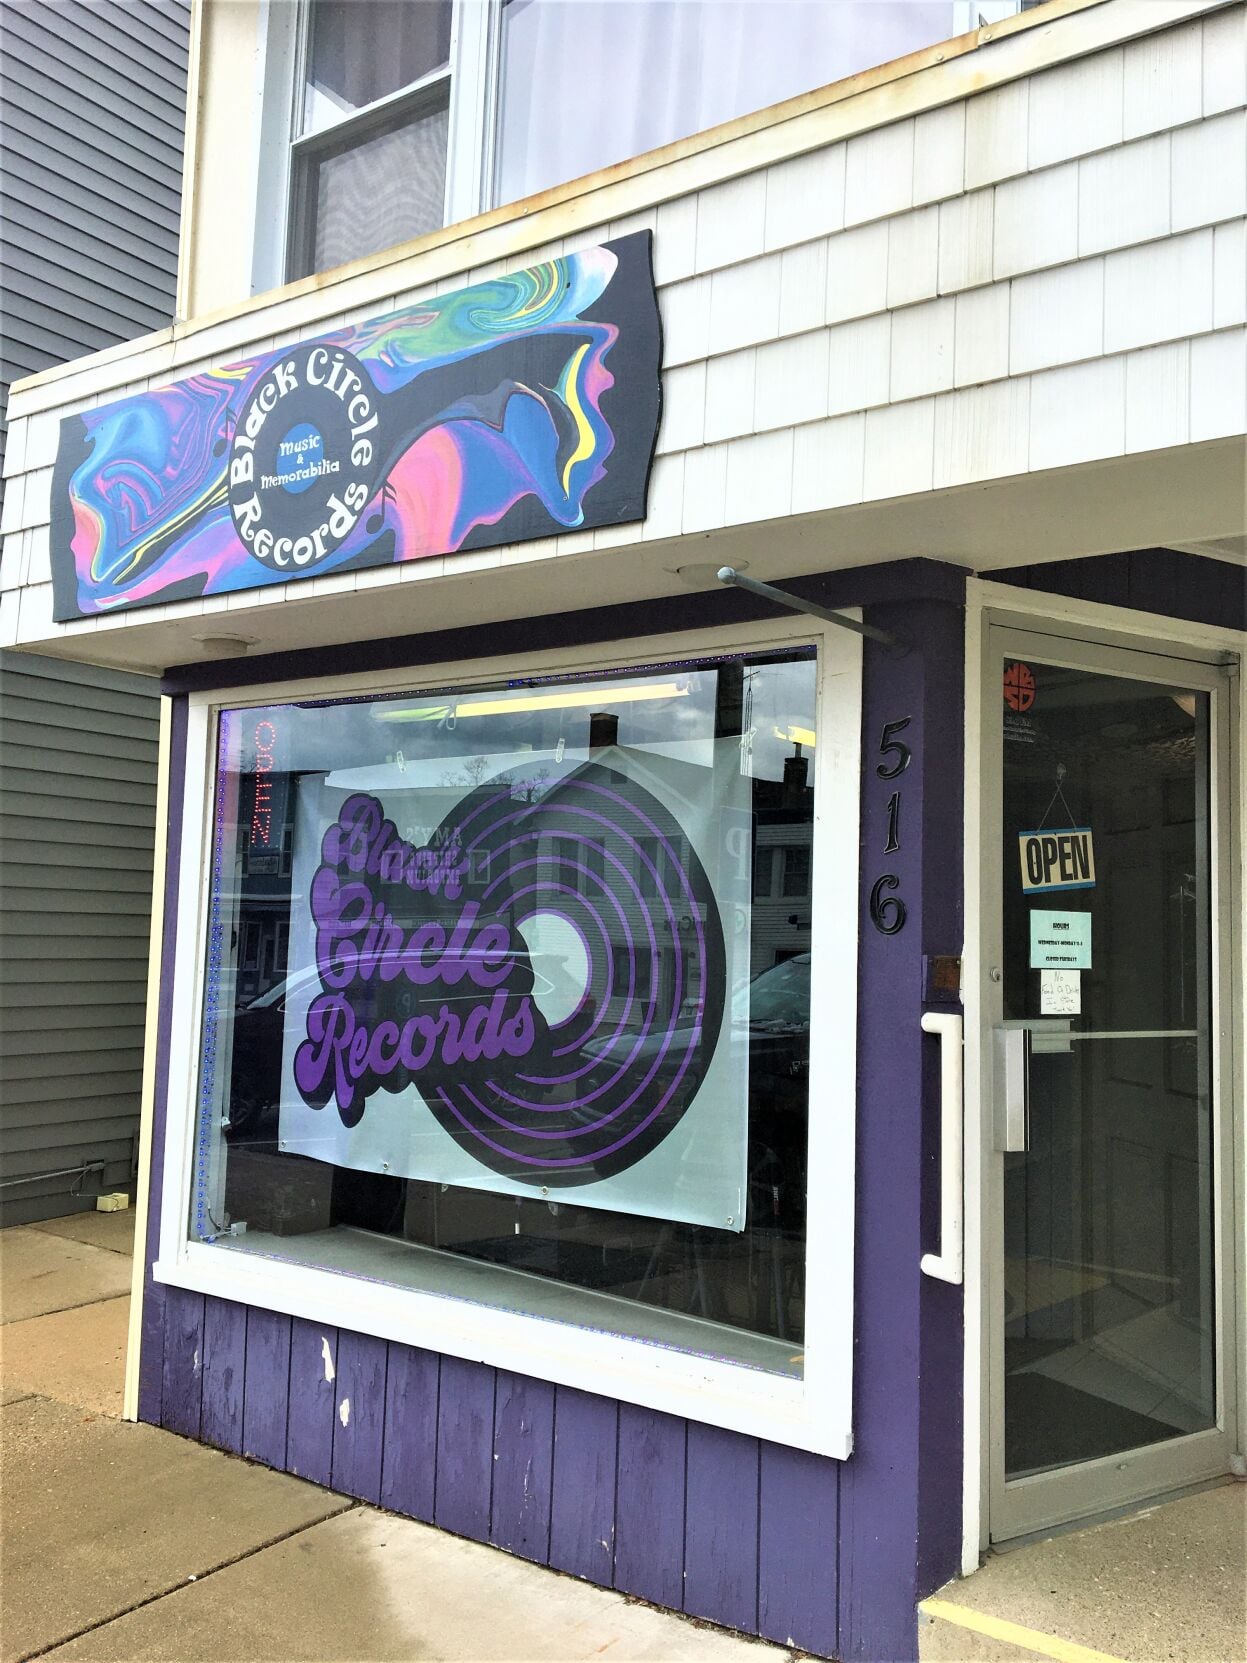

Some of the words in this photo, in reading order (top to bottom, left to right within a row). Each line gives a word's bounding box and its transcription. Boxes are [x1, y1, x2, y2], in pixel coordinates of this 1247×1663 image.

[231, 361, 298, 489] Black
[306, 348, 379, 466] Circle
[260, 459, 340, 489] Memorabilia
[233, 483, 369, 567] Records
[249, 719, 276, 847] OPEN
[325, 796, 471, 901] Black
[1026, 835, 1091, 886] OPEN
[311, 867, 515, 988] Circle
[295, 989, 536, 1110] Records
